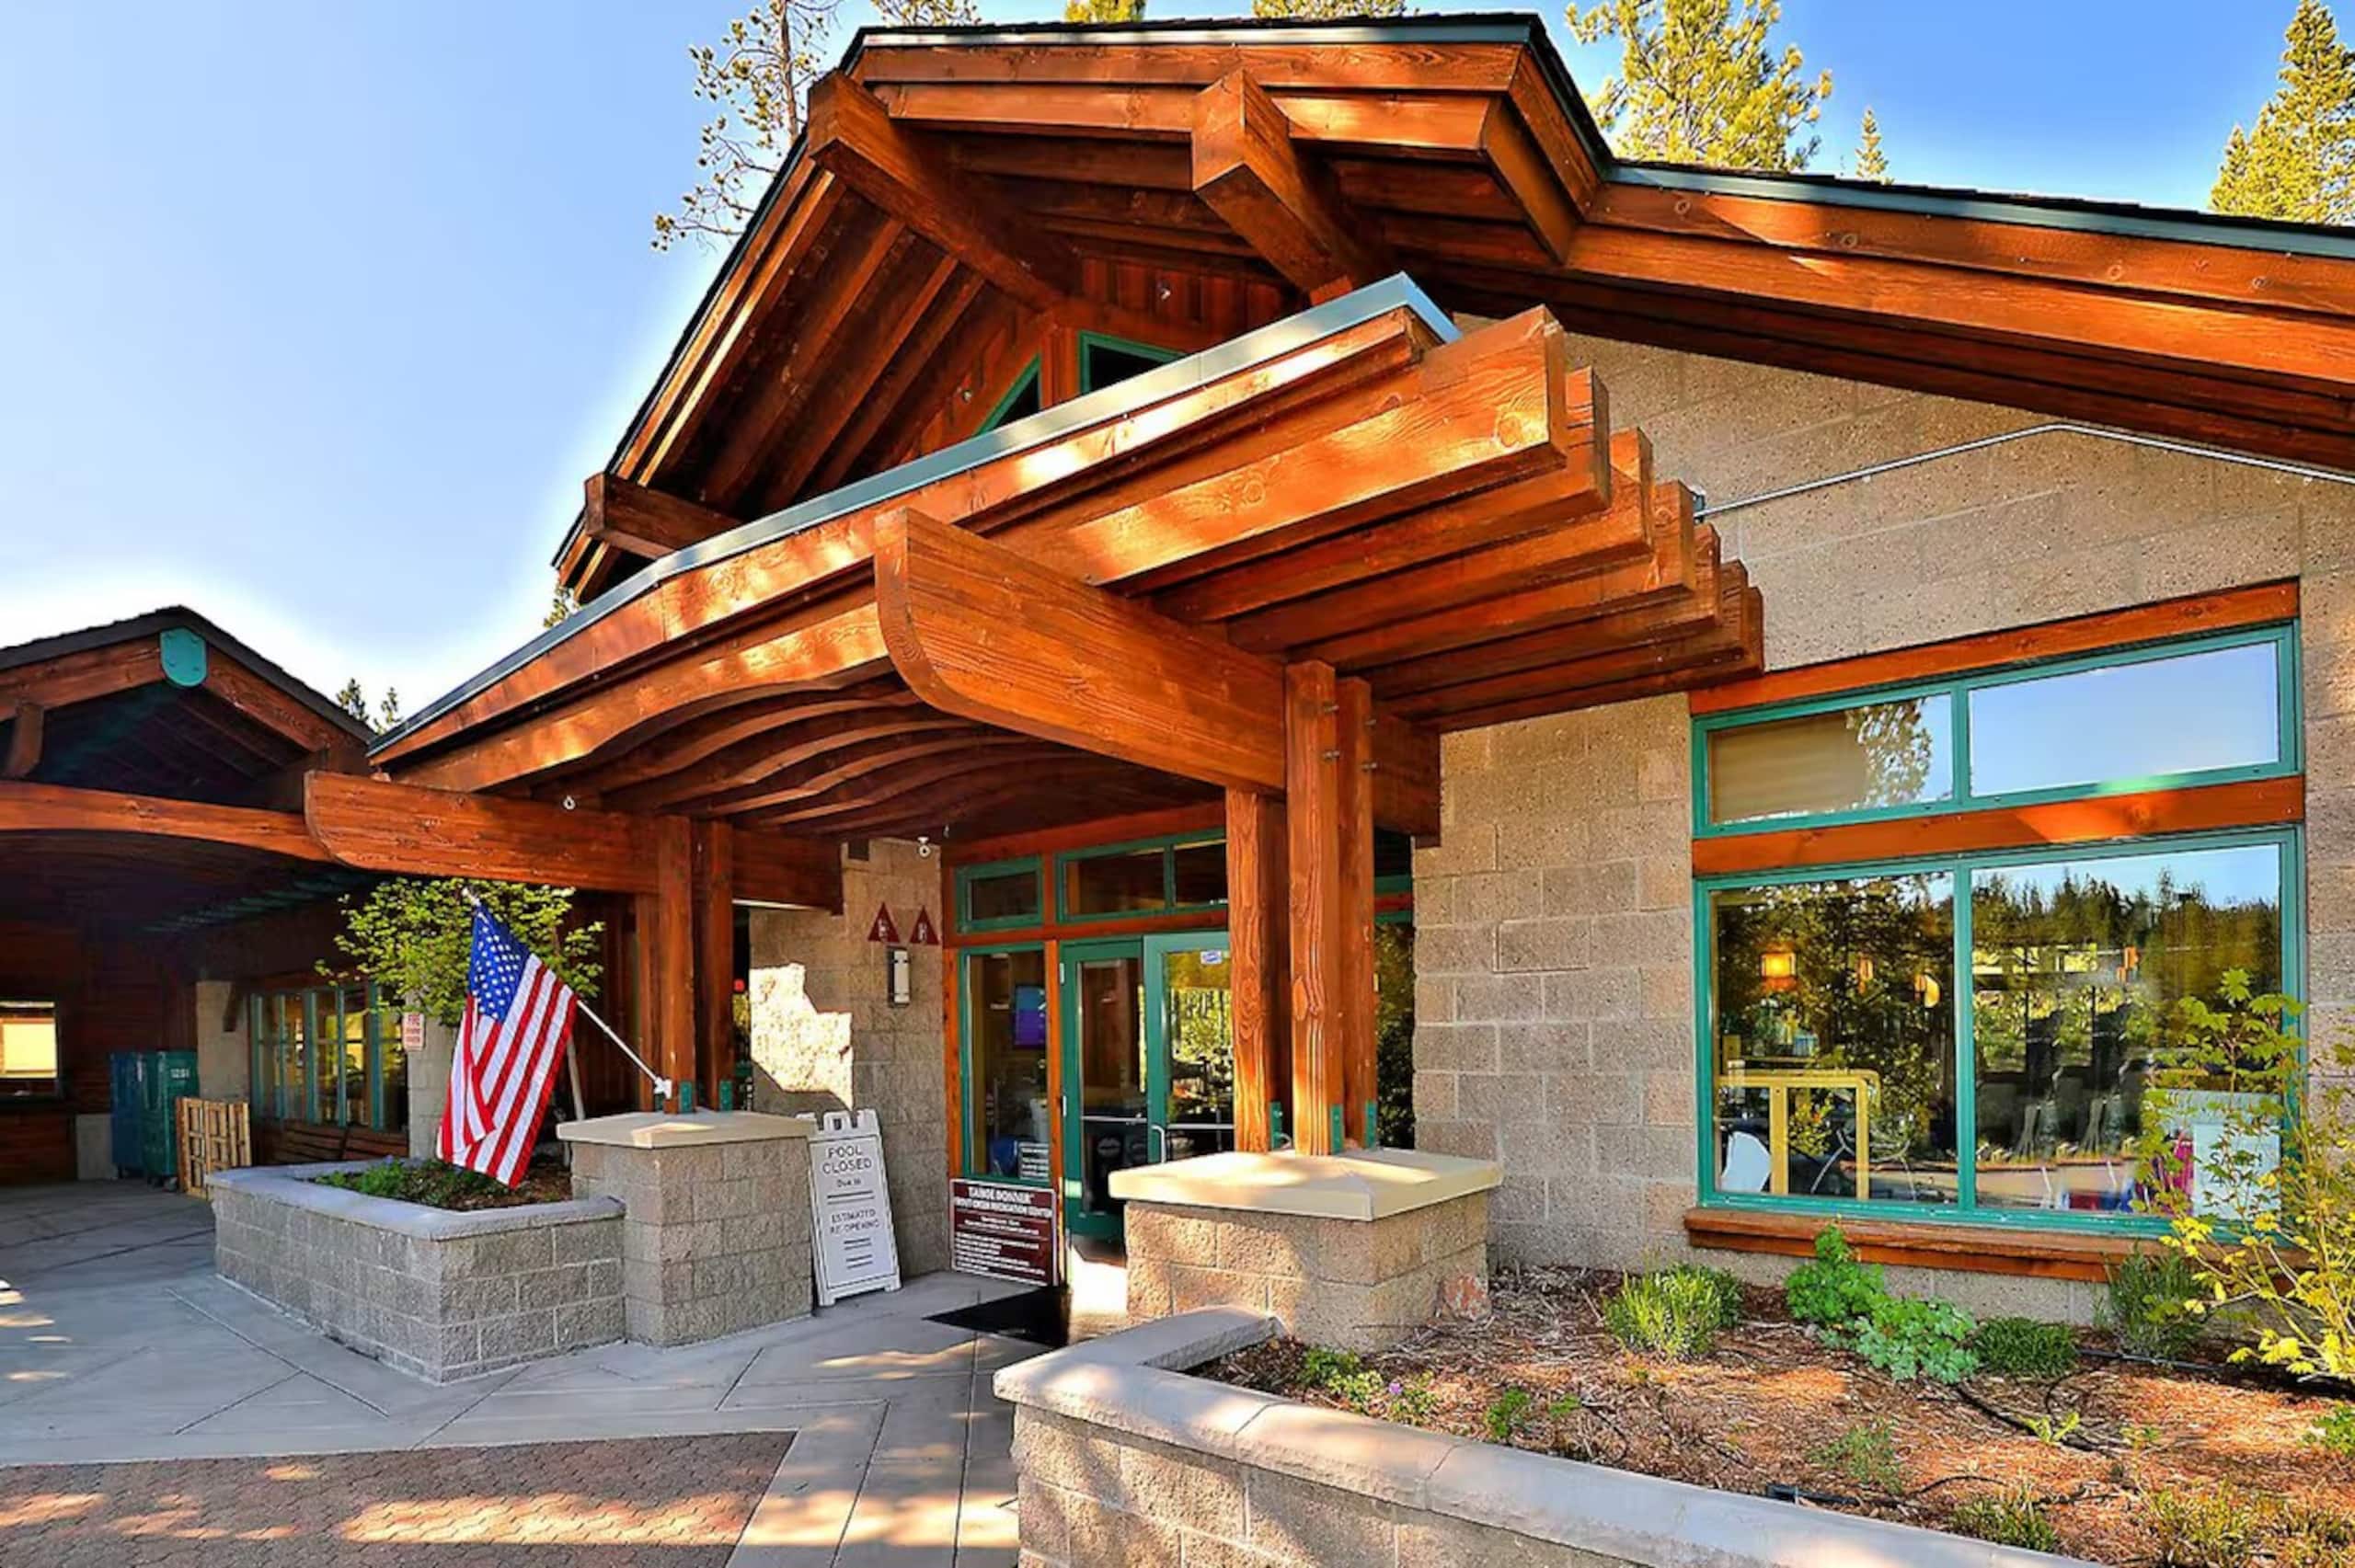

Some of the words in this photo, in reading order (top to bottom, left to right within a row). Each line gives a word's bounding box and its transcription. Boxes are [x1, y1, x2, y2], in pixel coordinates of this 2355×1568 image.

[828, 1146, 863, 1159] POOL
[822, 1158, 872, 1174] CLOSED
[832, 1208, 877, 1222] ESTIMATED
